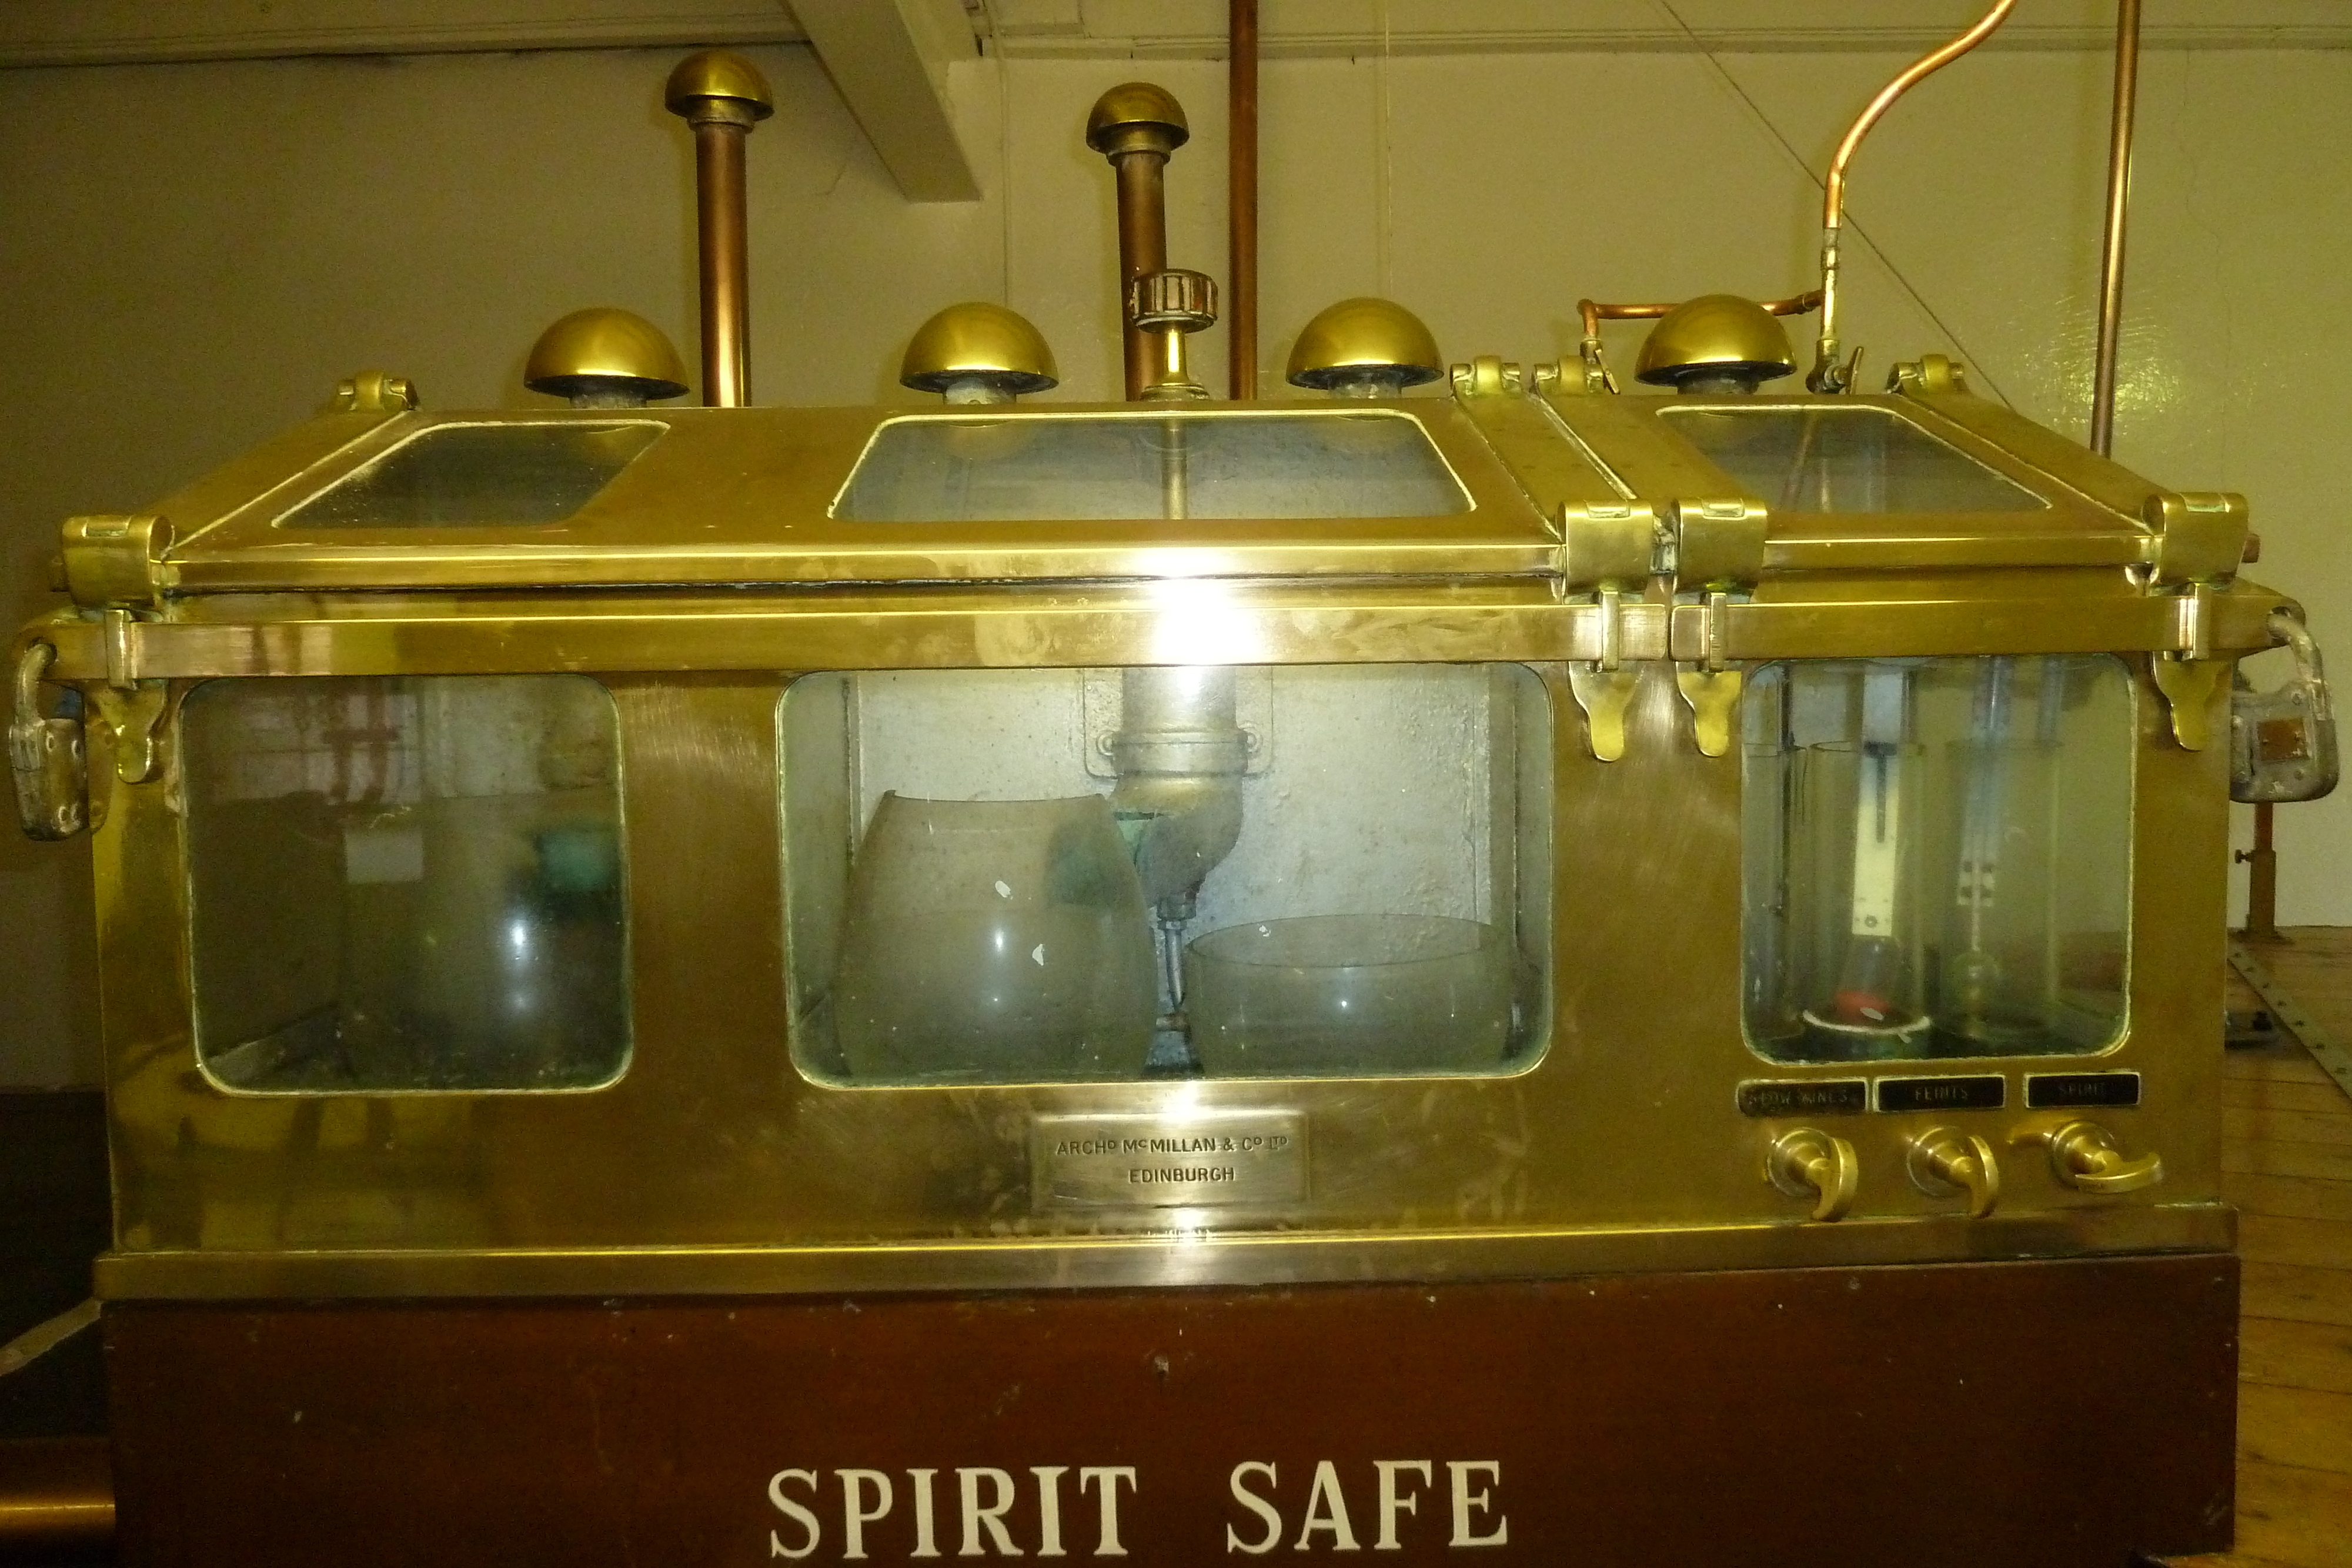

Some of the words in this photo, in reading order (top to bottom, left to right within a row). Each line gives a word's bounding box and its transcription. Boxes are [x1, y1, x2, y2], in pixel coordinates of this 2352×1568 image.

[1223, 1137, 1235, 1151] &
[1128, 1166, 1235, 1185] EDINBURGH
[768, 1466, 1137, 1559] SPIRIT
[1227, 1459, 1508, 1555] SAFE
